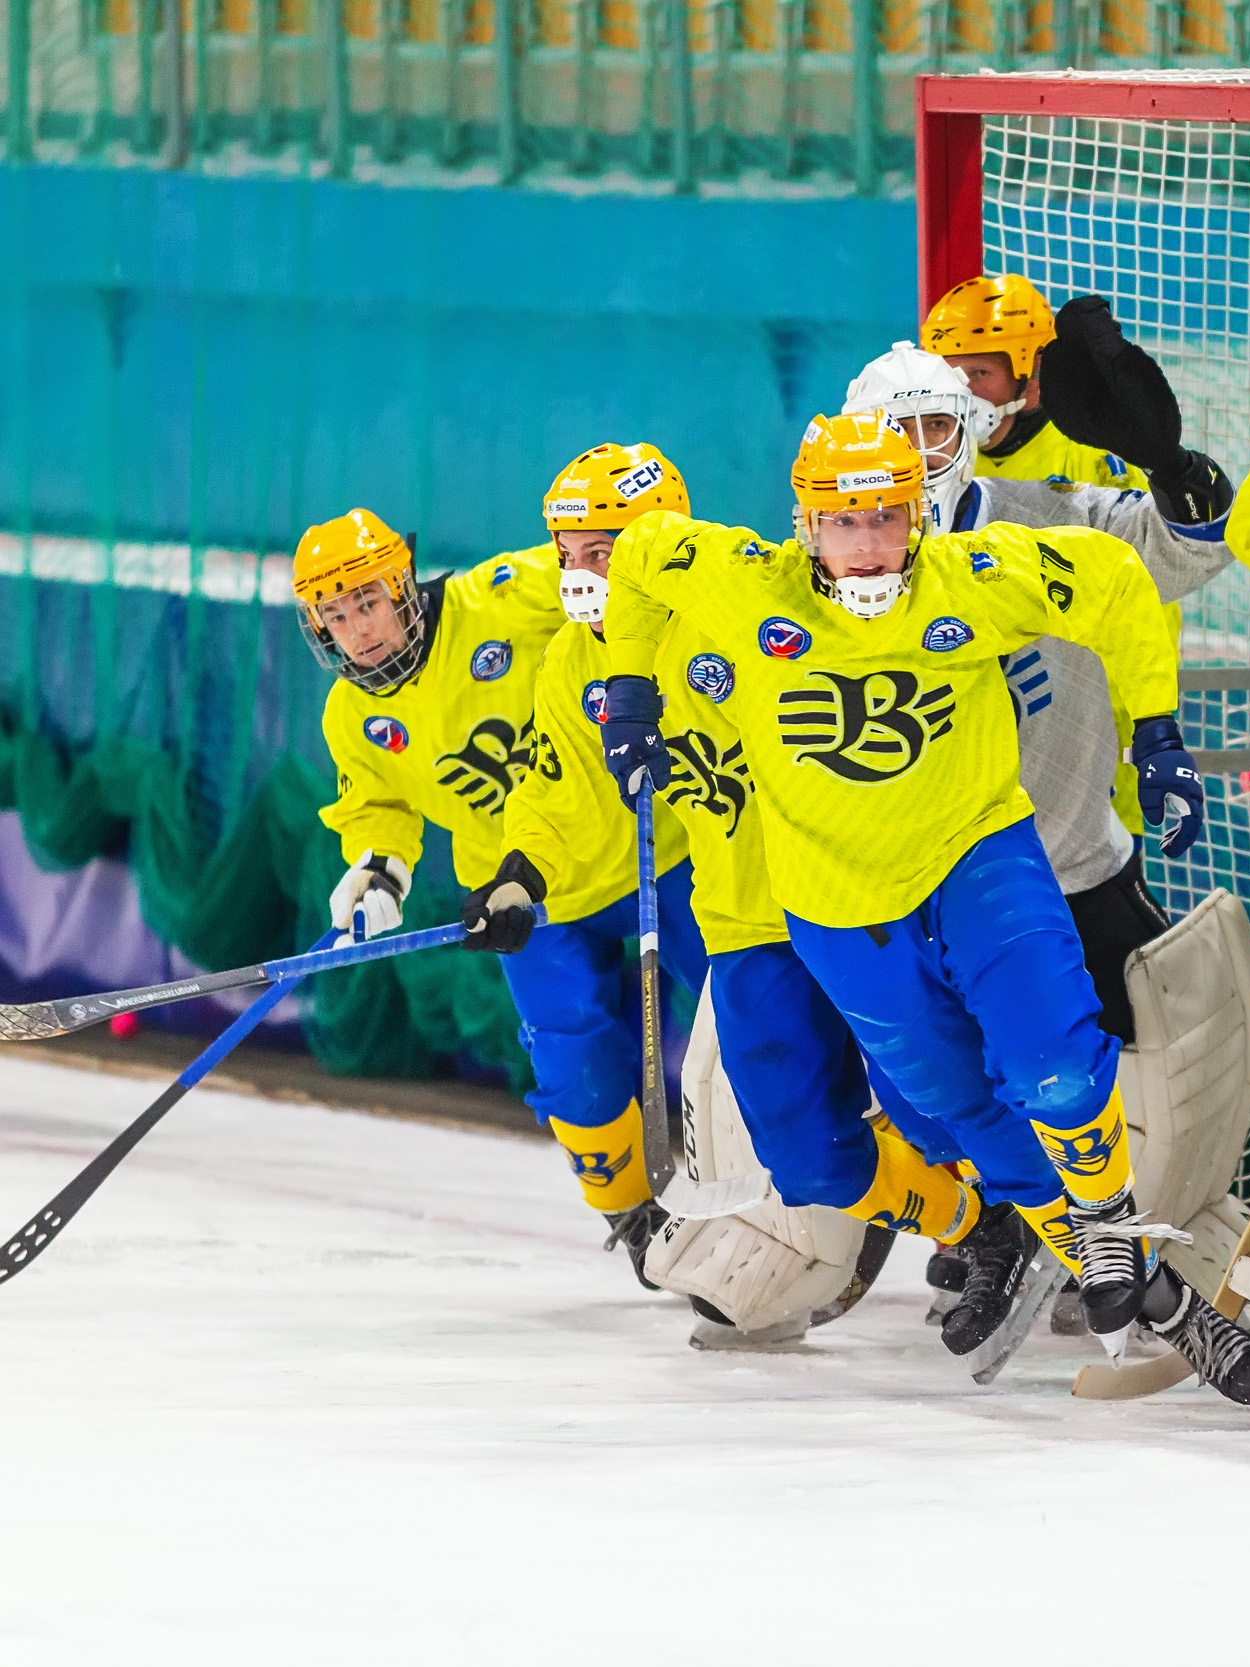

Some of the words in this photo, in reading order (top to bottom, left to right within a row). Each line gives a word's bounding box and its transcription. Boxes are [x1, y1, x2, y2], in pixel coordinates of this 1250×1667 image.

[893, 388, 933, 399] CCM
[853, 474, 892, 486] ŠKODA
[555, 503, 586, 512] ŠKODA
[308, 566, 341, 585] BAUER
[682, 1091, 701, 1183] CCM
[1003, 1253, 1024, 1297] CCM
